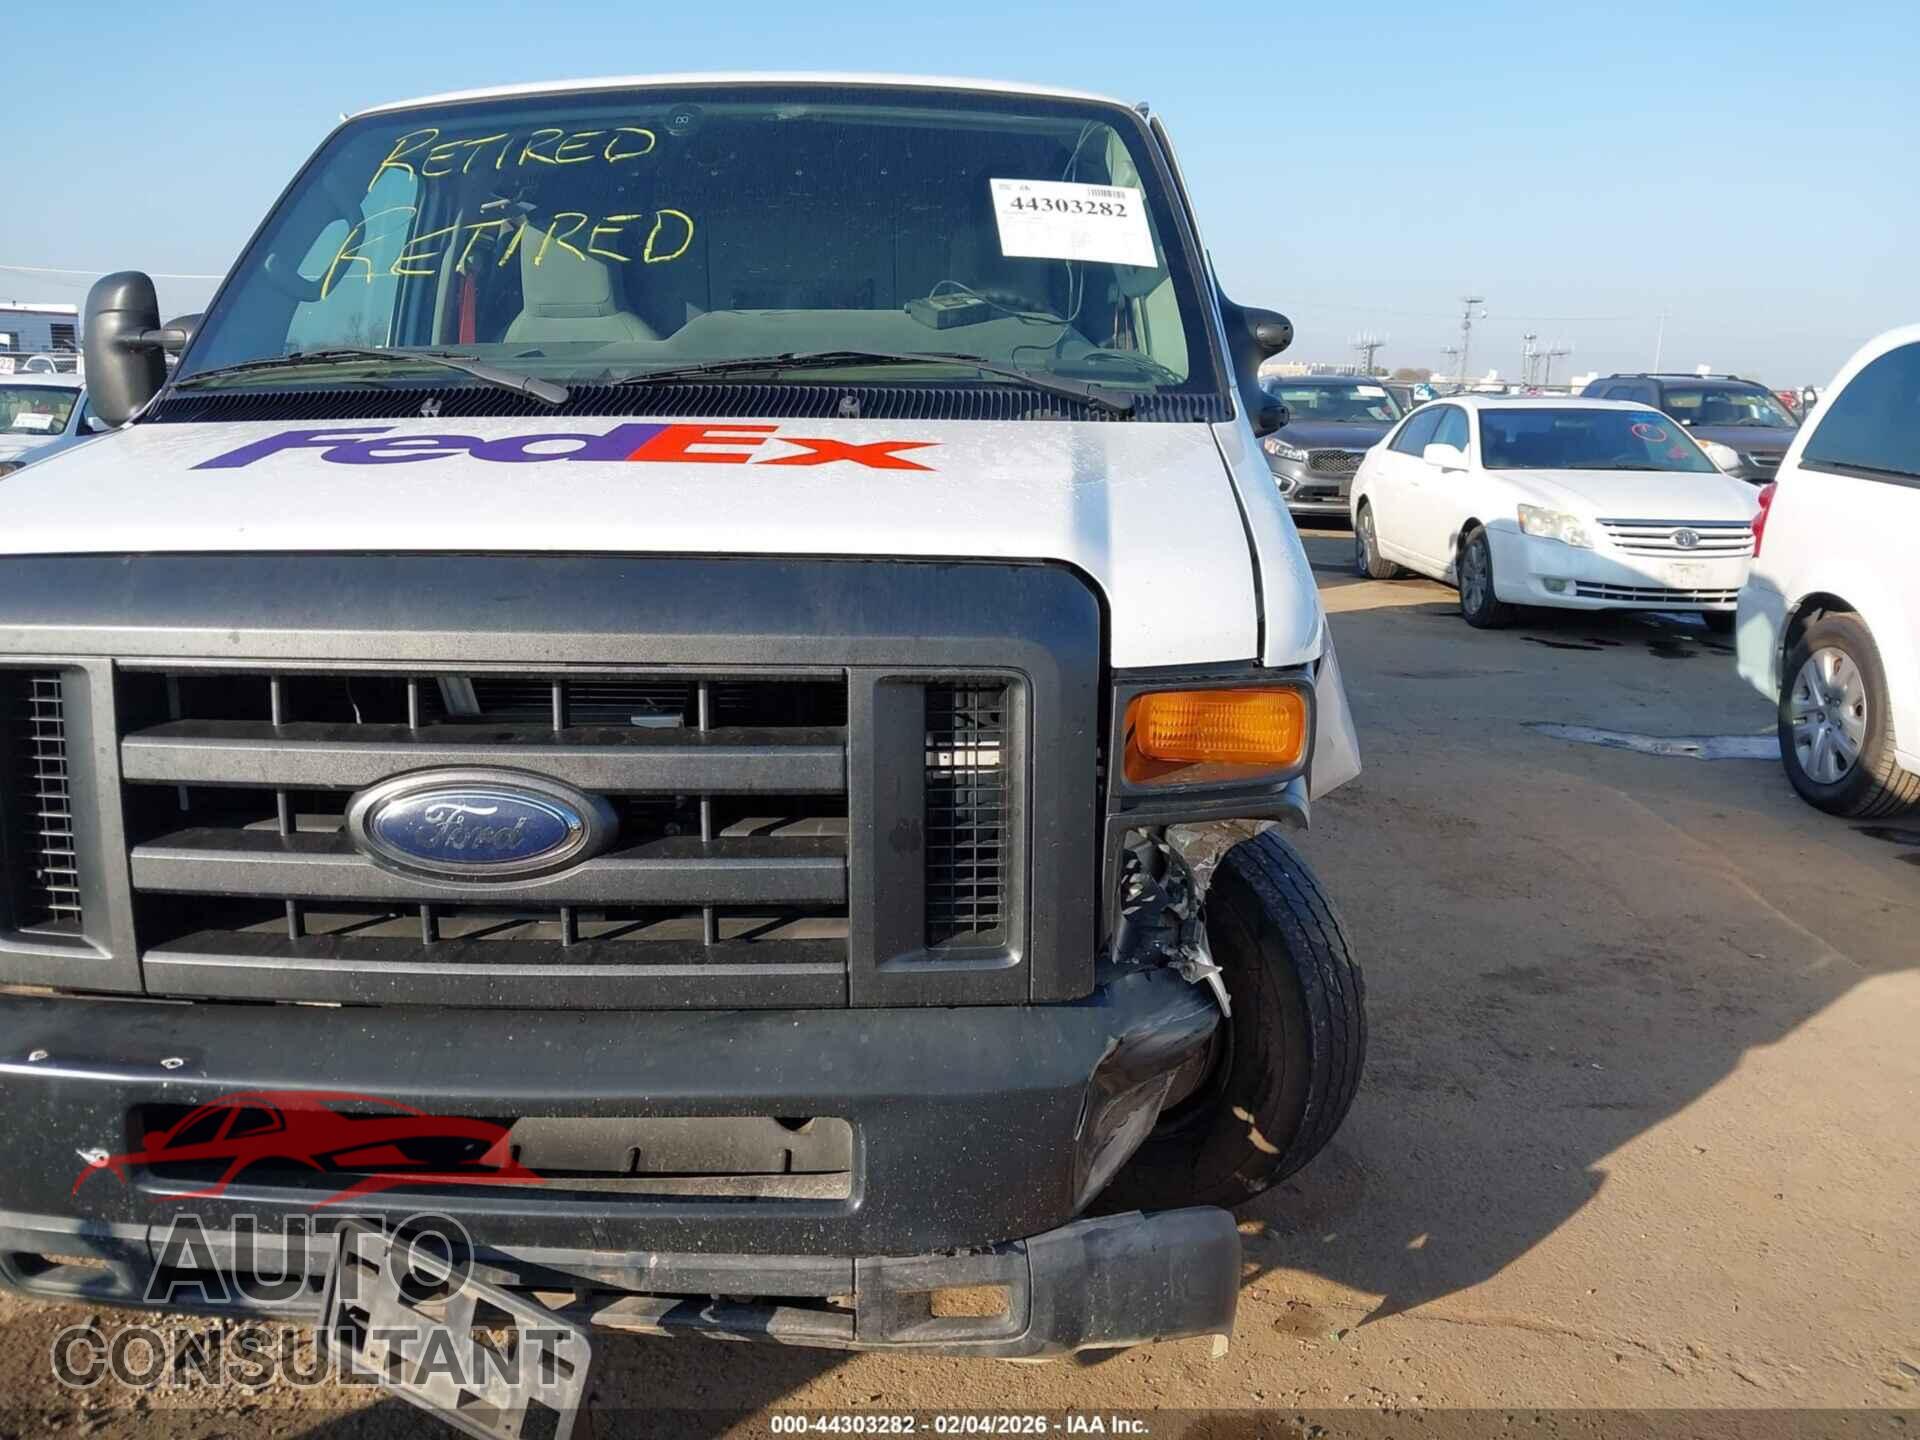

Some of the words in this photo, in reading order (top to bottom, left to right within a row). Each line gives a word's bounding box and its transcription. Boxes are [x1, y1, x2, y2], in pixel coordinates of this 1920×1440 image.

[368, 128, 655, 192] RETIRED
[1010, 196, 1127, 217] 44303282
[322, 206, 694, 300] RETIRED
[186, 423, 943, 472] FedEx
[424, 803, 527, 850] Ford
